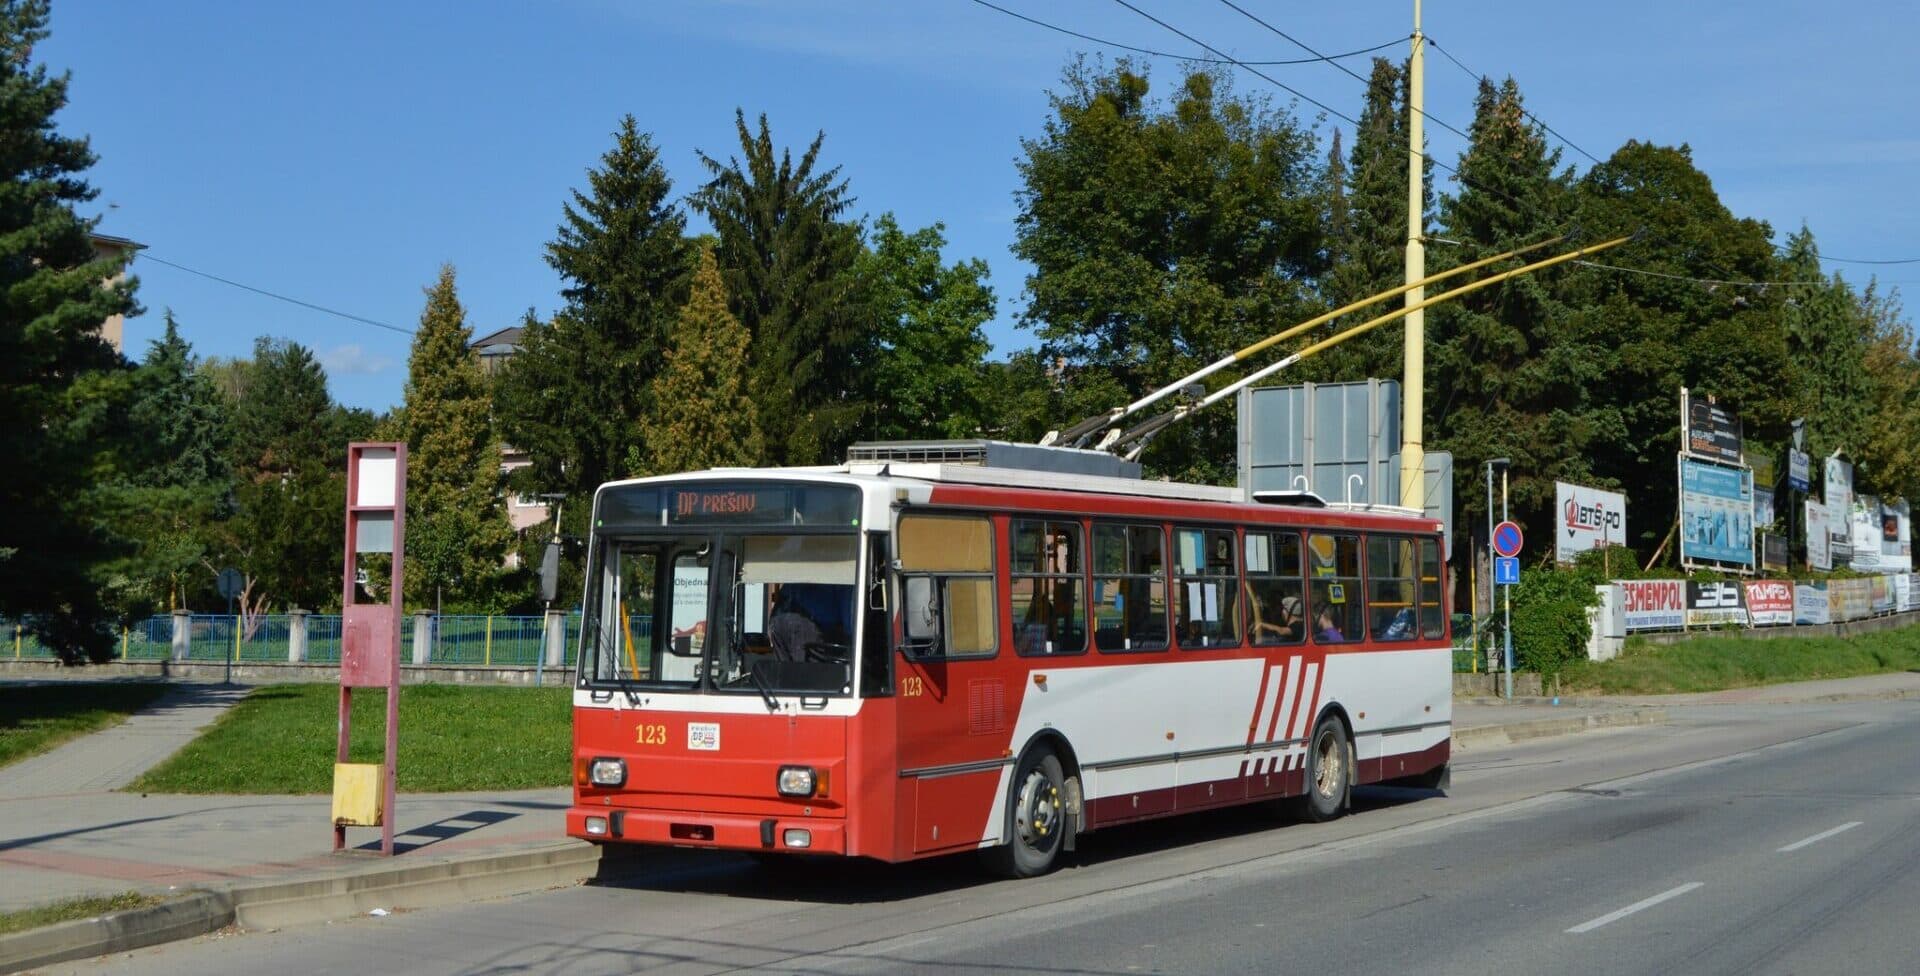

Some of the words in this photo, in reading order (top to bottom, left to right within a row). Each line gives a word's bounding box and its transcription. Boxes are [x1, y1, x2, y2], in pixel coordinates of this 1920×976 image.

[678, 492, 698, 515] DP
[703, 491, 755, 512] PREŠOV
[902, 677, 922, 696] 123
[635, 724, 666, 744] 123
